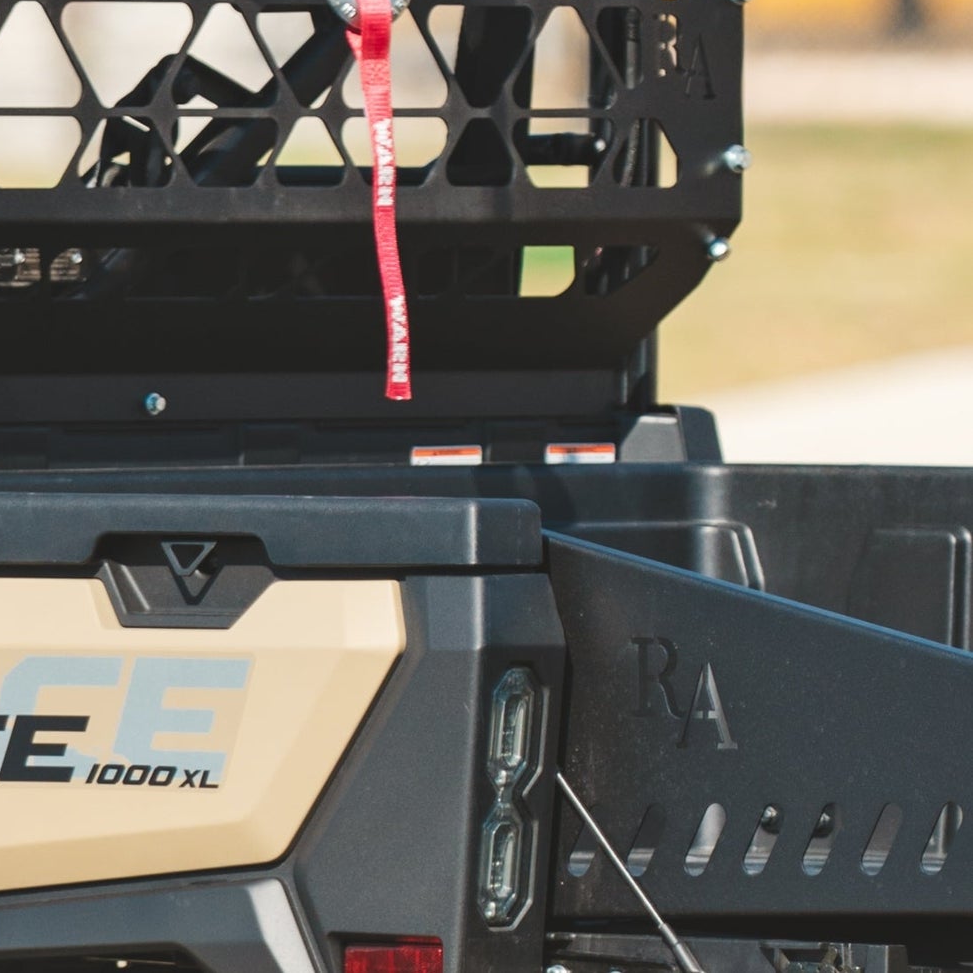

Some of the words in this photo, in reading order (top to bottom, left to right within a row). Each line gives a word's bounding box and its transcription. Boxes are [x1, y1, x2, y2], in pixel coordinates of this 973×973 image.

[373, 118, 394, 206] WARN
[388, 295, 408, 383] WARN
[630, 637, 738, 749] RA
[85, 764, 177, 786] 1000
[179, 769, 219, 788] XL
